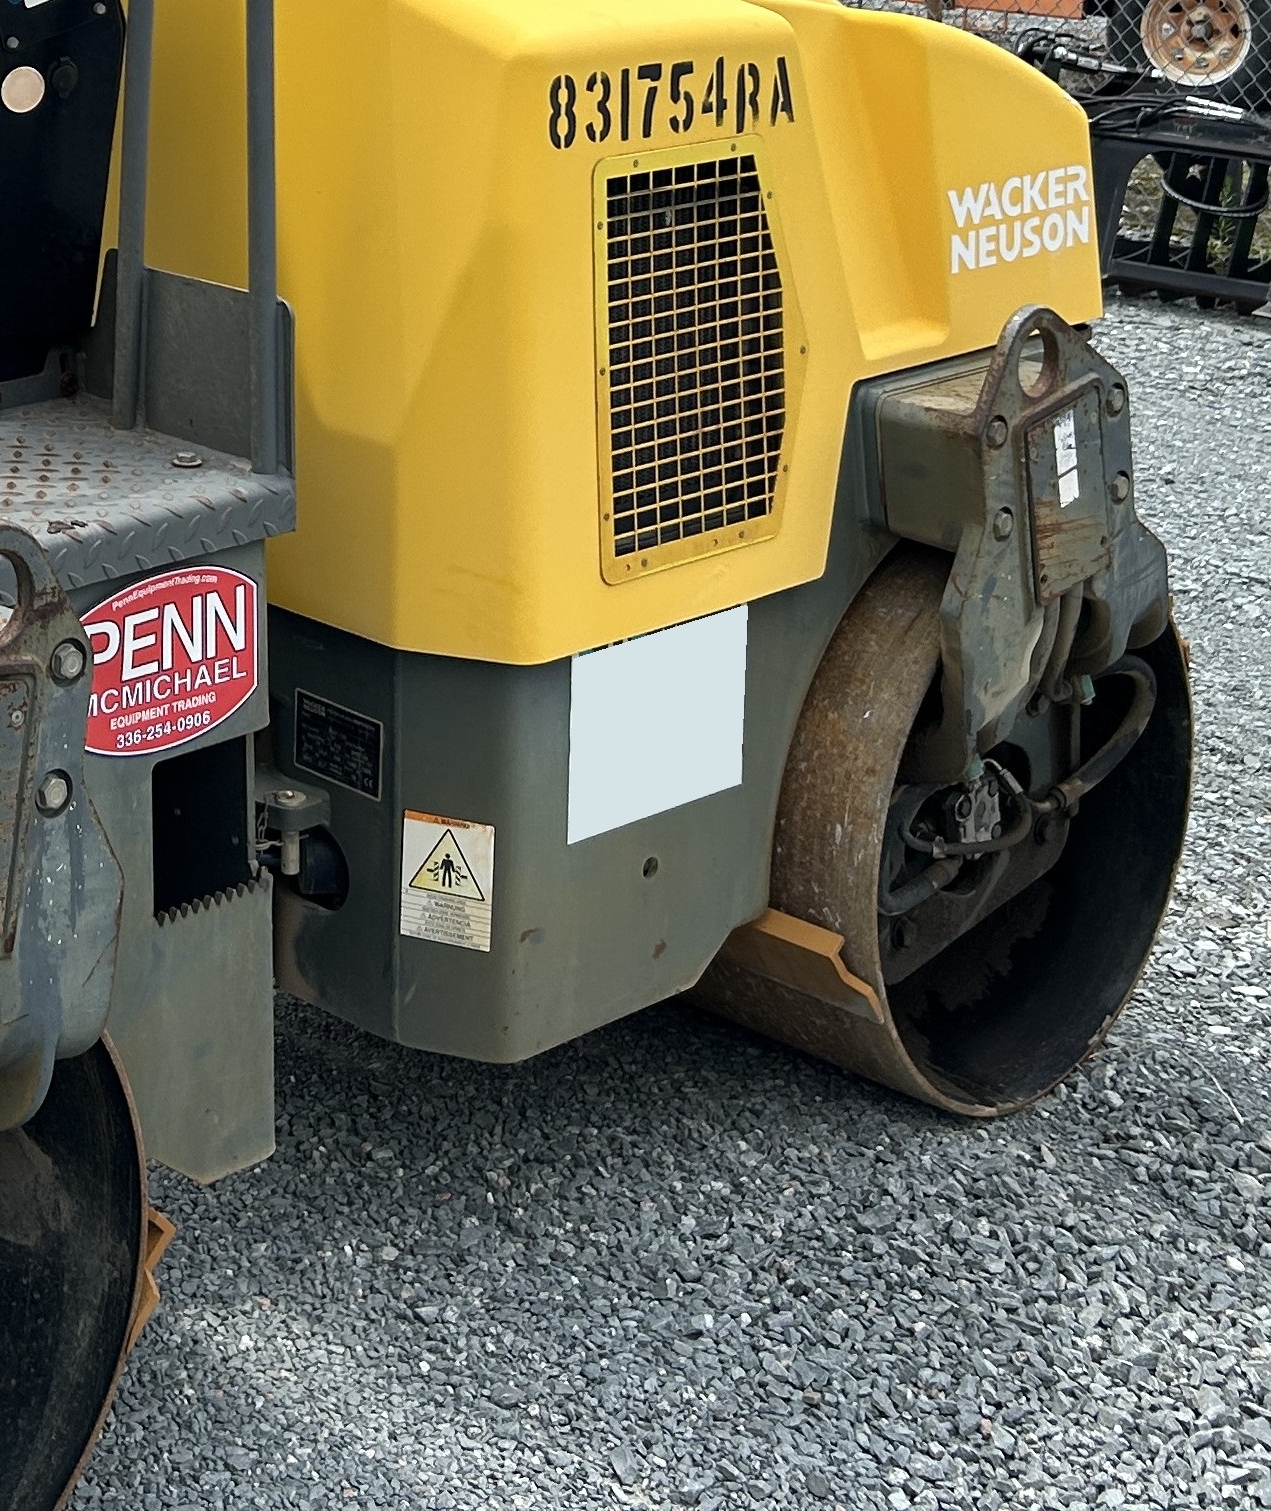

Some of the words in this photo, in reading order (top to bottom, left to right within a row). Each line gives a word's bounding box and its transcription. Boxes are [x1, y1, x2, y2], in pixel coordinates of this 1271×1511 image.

[549, 56, 795, 149] 831754RA
[948, 165, 1090, 228] WACKER
[951, 206, 1090, 274] NEUSON
[84, 584, 246, 682] PENN
[110, 704, 170, 730] EQUIPMENT
[172, 691, 216, 712] TRADING
[117, 710, 211, 748] 336-254-0906
